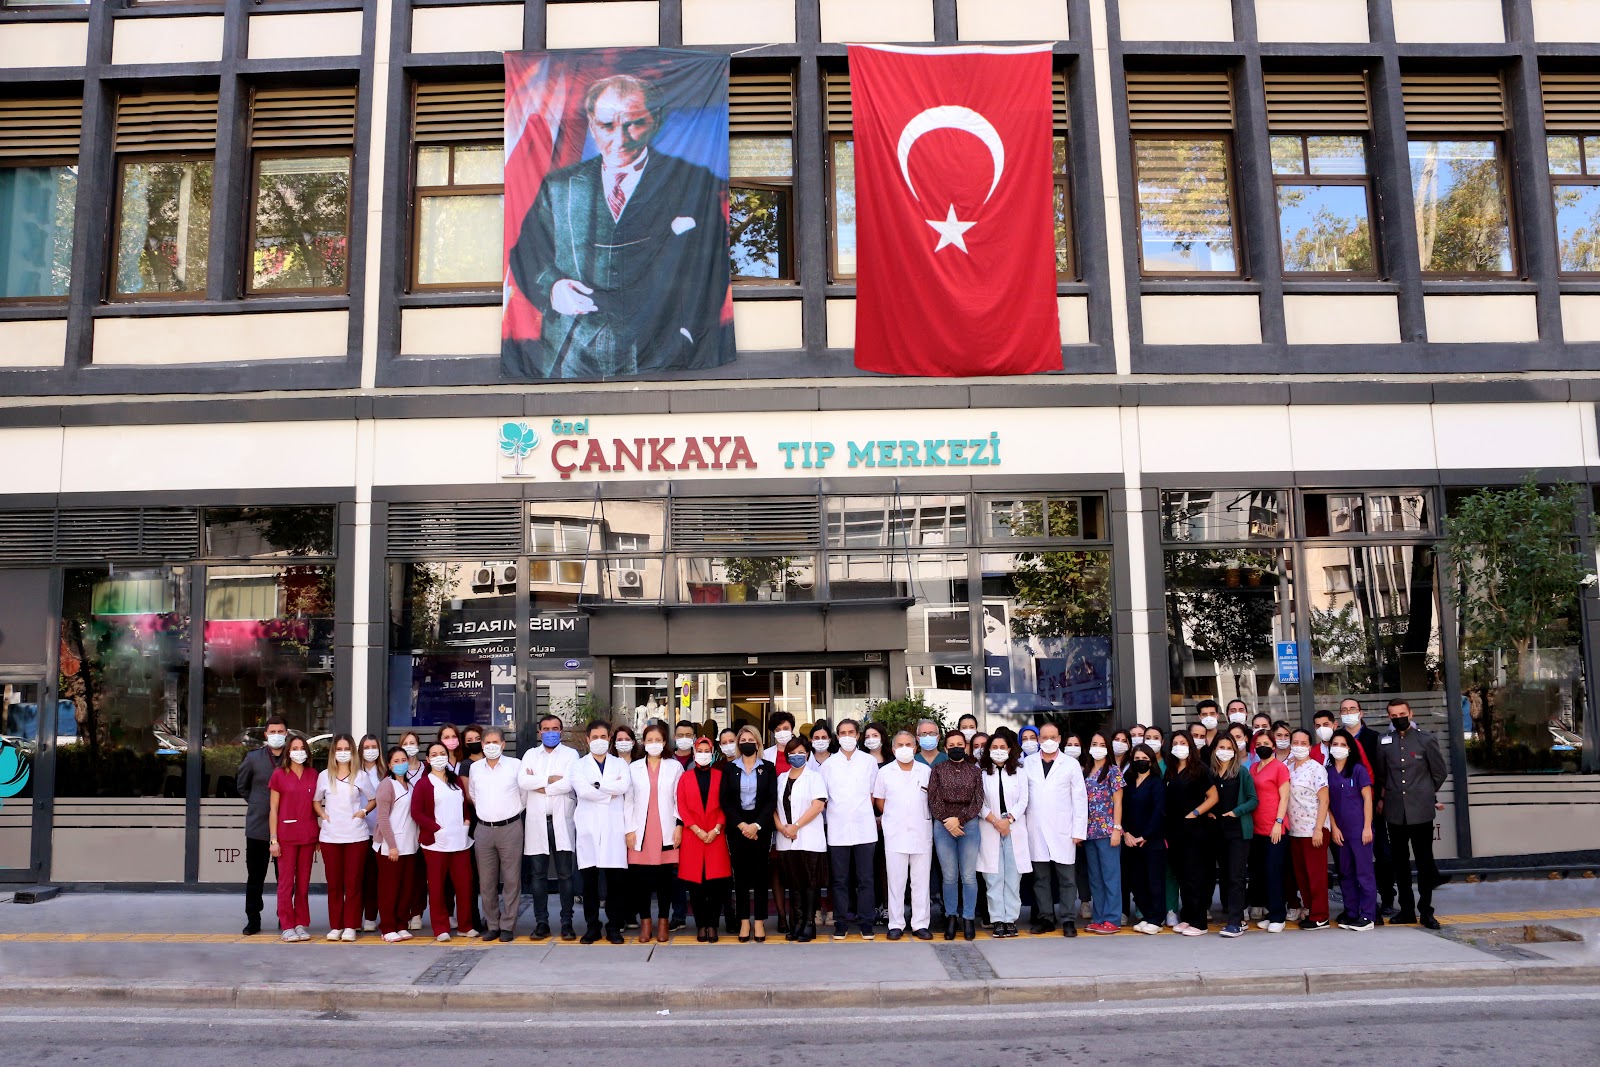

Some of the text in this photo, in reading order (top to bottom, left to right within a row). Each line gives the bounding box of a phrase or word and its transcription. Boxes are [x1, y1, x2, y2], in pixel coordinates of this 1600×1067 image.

[551, 415, 590, 436] özel
[551, 431, 1003, 480] ÇANKAYA TIP MERKEZİ
[214, 848, 241, 863] TIP
